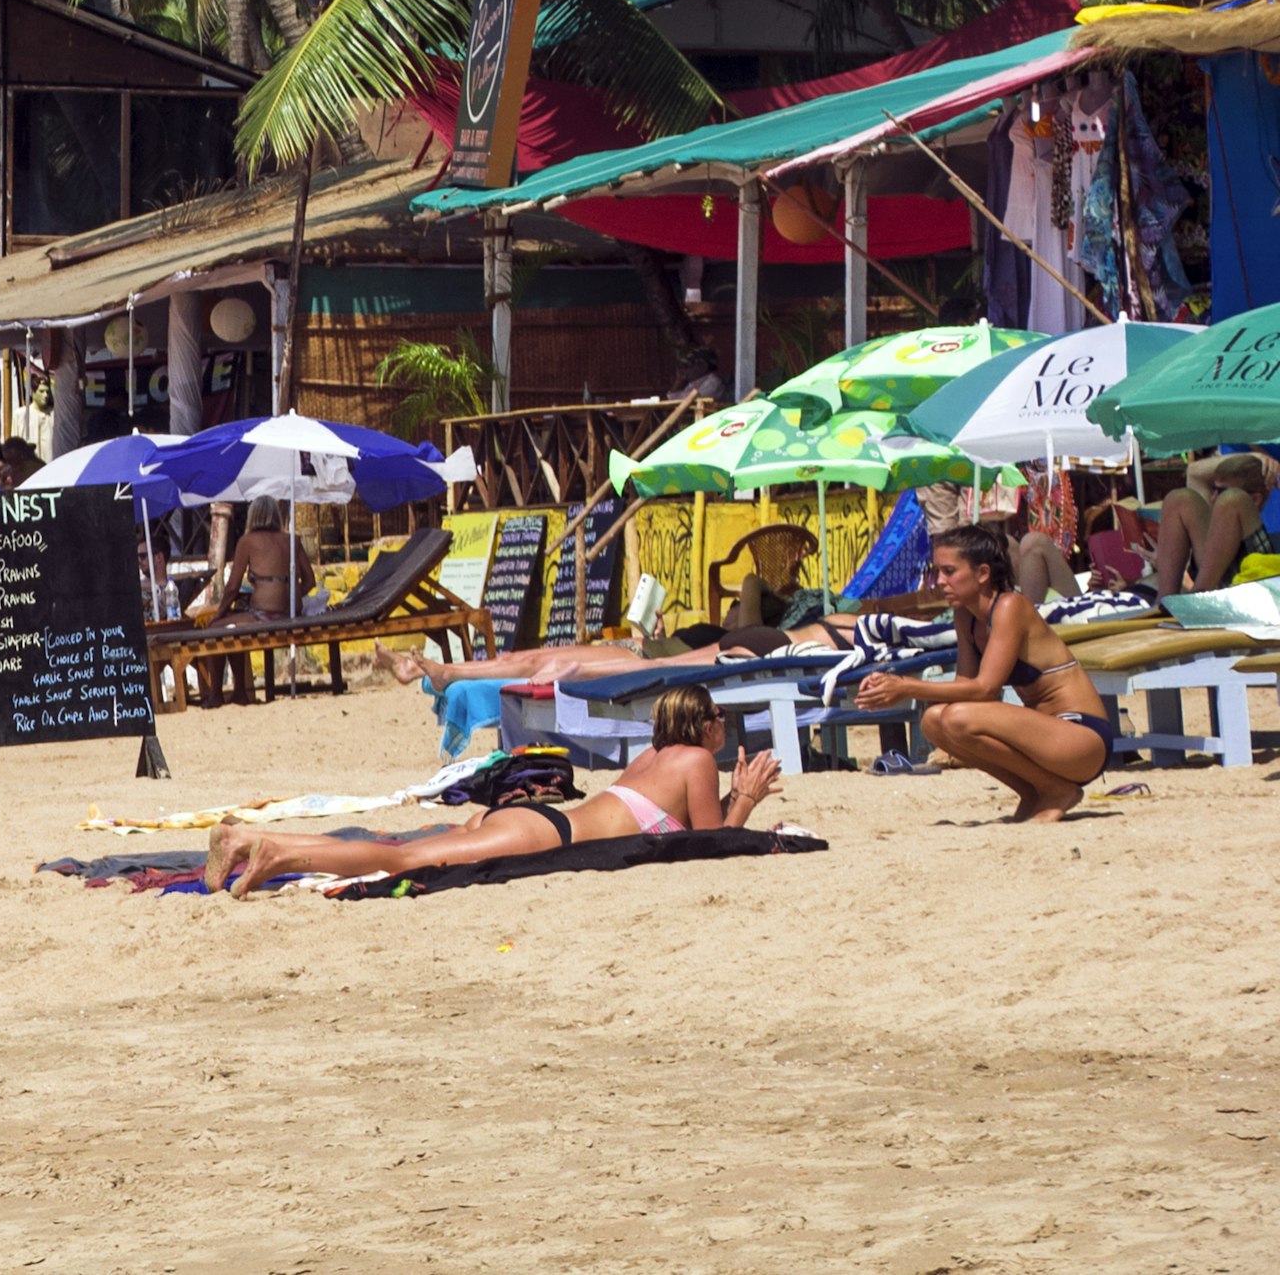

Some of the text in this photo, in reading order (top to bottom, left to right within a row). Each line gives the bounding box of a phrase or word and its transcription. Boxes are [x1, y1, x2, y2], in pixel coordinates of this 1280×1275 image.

[1223, 327, 1280, 352] Le
[1038, 353, 1094, 376] Le
[125, 352, 235, 406] LOE
[1, 492, 62, 524] NEST
[101, 625, 125, 643] YOUR
[49, 653, 80, 668] CHOICE
[33, 670, 62, 687] GARLIC
[67, 667, 95, 682] SAUCE
[103, 664, 117, 678] OR
[12, 682, 145, 709] GARLIC SAUCE SERVED WITH
[13, 712, 36, 732] RICE
[58, 707, 83, 724] CHIPS
[88, 706, 109, 723] AND
[115, 703, 146, 720] SALAD
